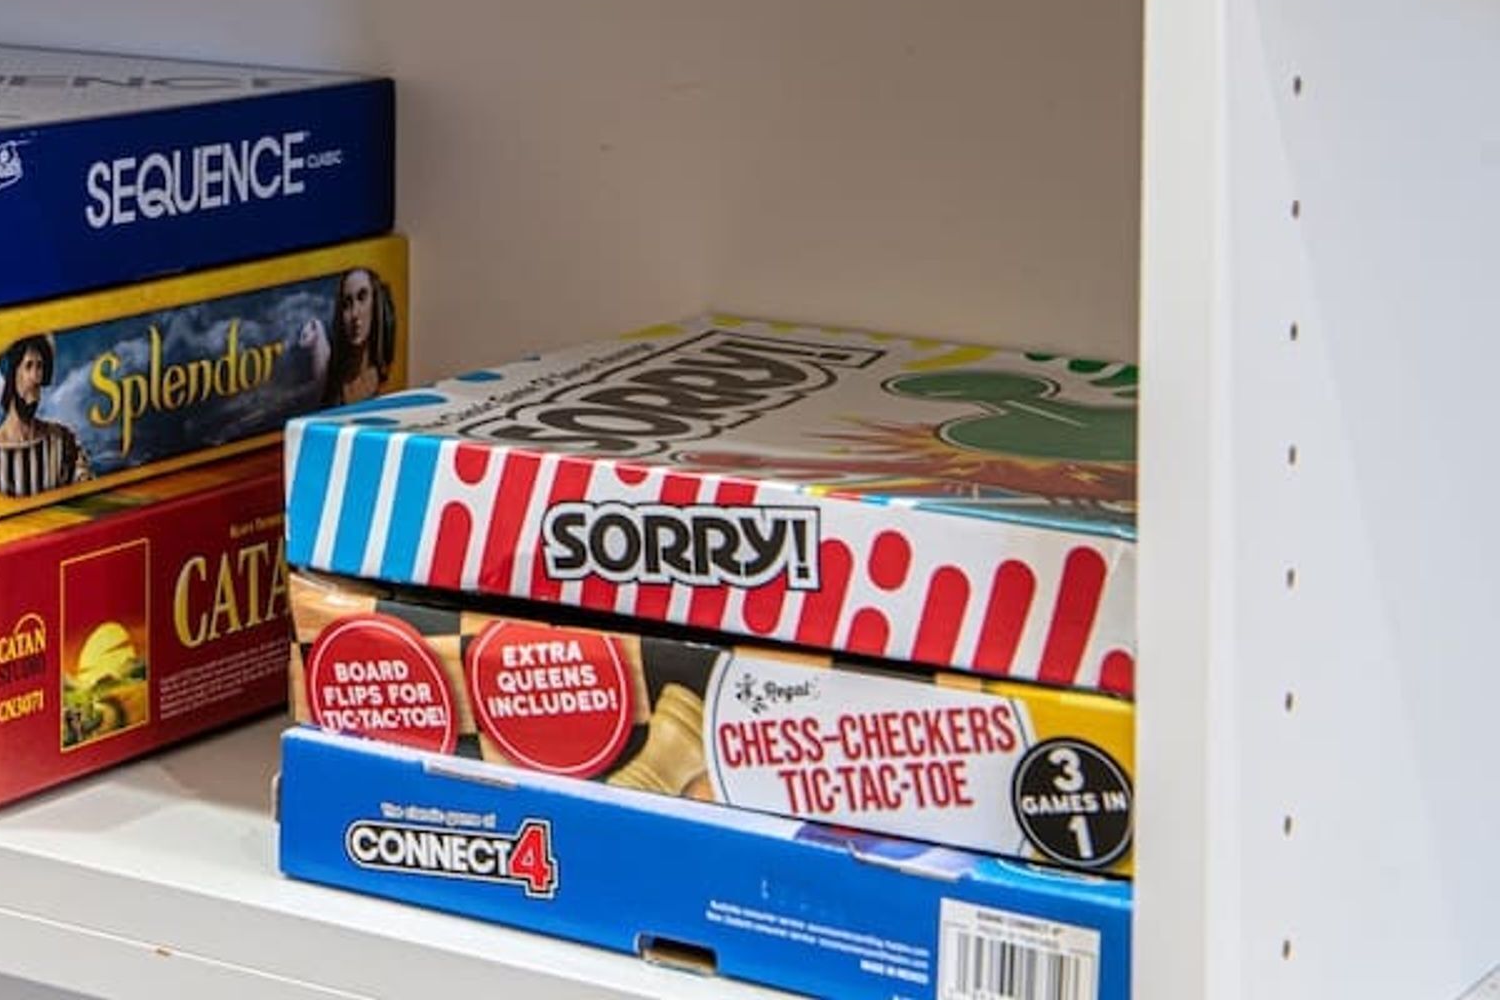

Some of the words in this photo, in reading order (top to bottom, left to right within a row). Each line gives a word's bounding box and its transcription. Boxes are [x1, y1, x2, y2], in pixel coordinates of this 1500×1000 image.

[86, 131, 306, 229] SEQUENCE
[89, 317, 287, 458] Splendor
[490, 339, 853, 452] SORRY!
[551, 512, 812, 579] SORRY!
[172, 536, 288, 648] CATA
[334, 660, 409, 683] BOARD
[502, 641, 584, 668] EXTRA
[322, 685, 381, 709] FLIPS
[387, 681, 432, 704] FOR
[497, 664, 598, 692] QUEENS
[488, 689, 619, 719] INCLUDED!
[717, 703, 1018, 769] CHESS-CHECKERS
[1047, 747, 1085, 792] 3
[1020, 792, 1100, 816] GAMES
[1101, 790, 1128, 812] IN
[1067, 814, 1095, 859] 1
